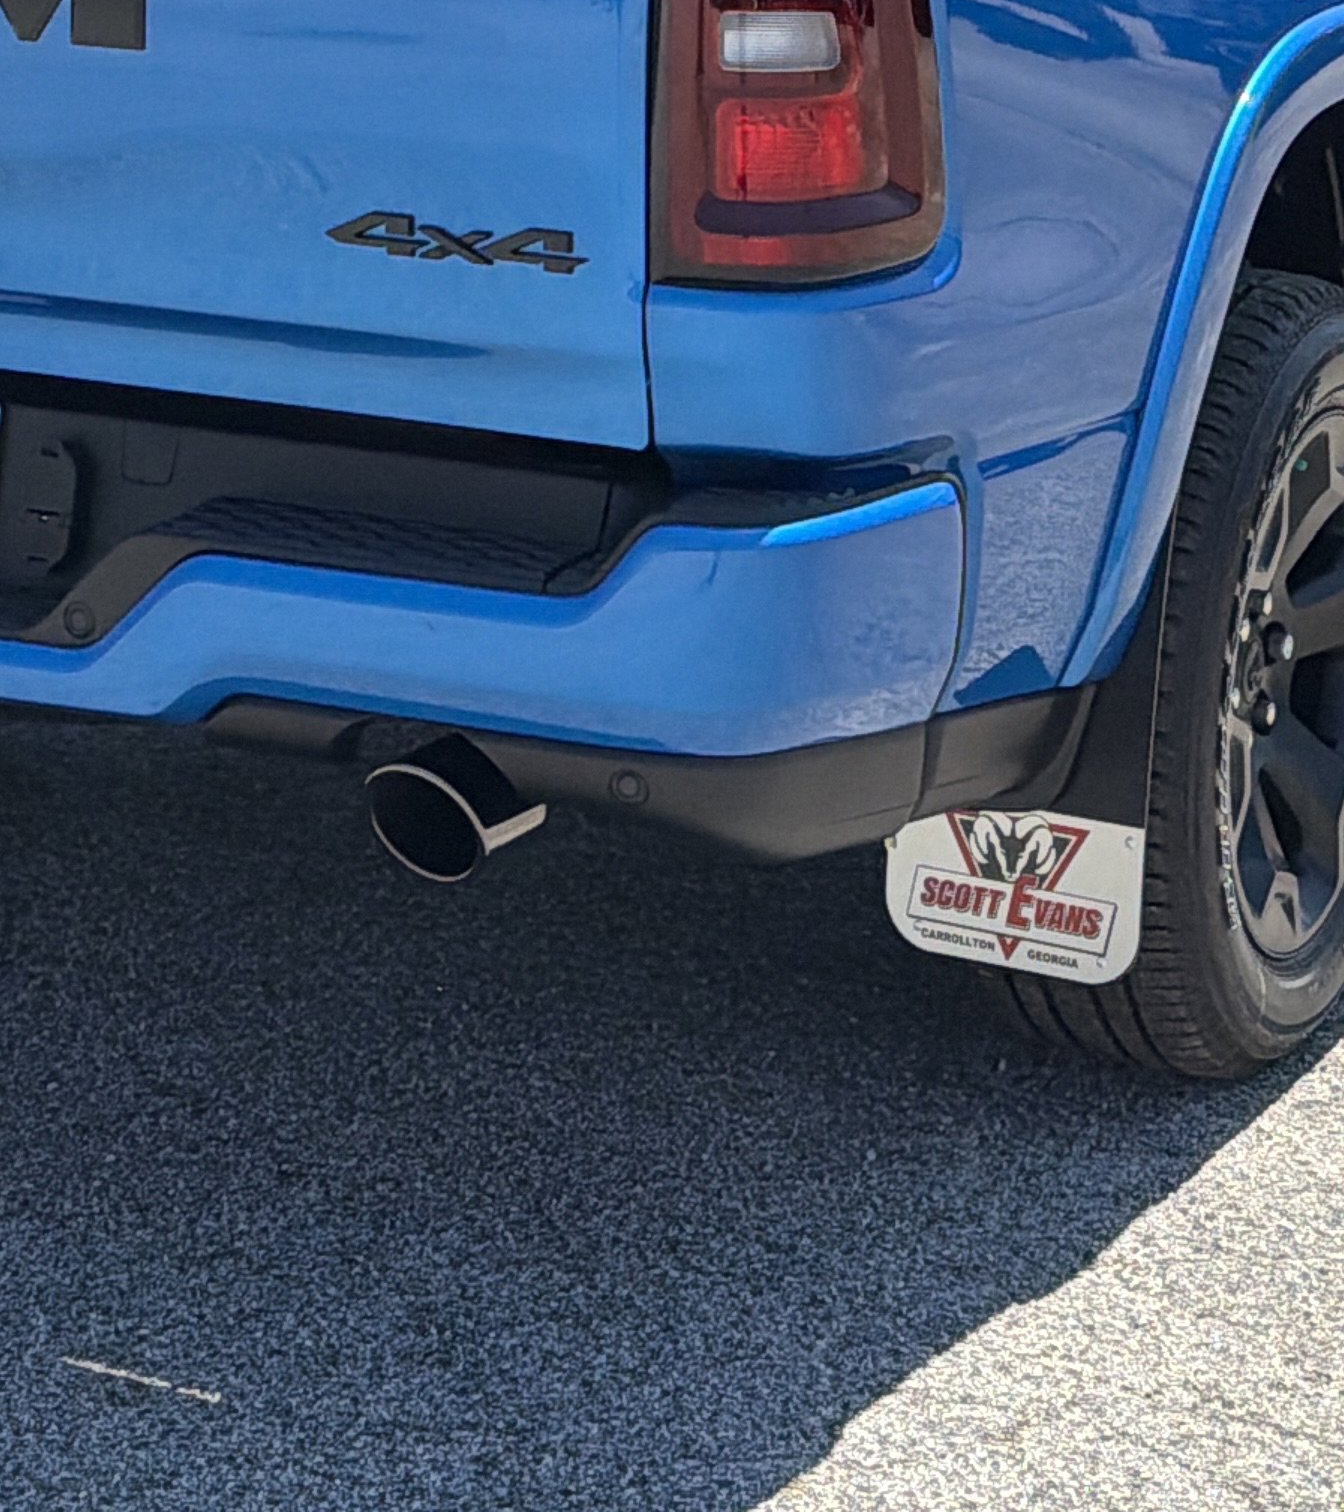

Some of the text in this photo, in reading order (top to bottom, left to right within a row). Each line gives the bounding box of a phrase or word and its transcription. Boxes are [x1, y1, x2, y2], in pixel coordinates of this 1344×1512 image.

[920, 874, 1104, 940] SCOTT EVANS
[920, 927, 1079, 969] CARROLLTON GEORGIA
